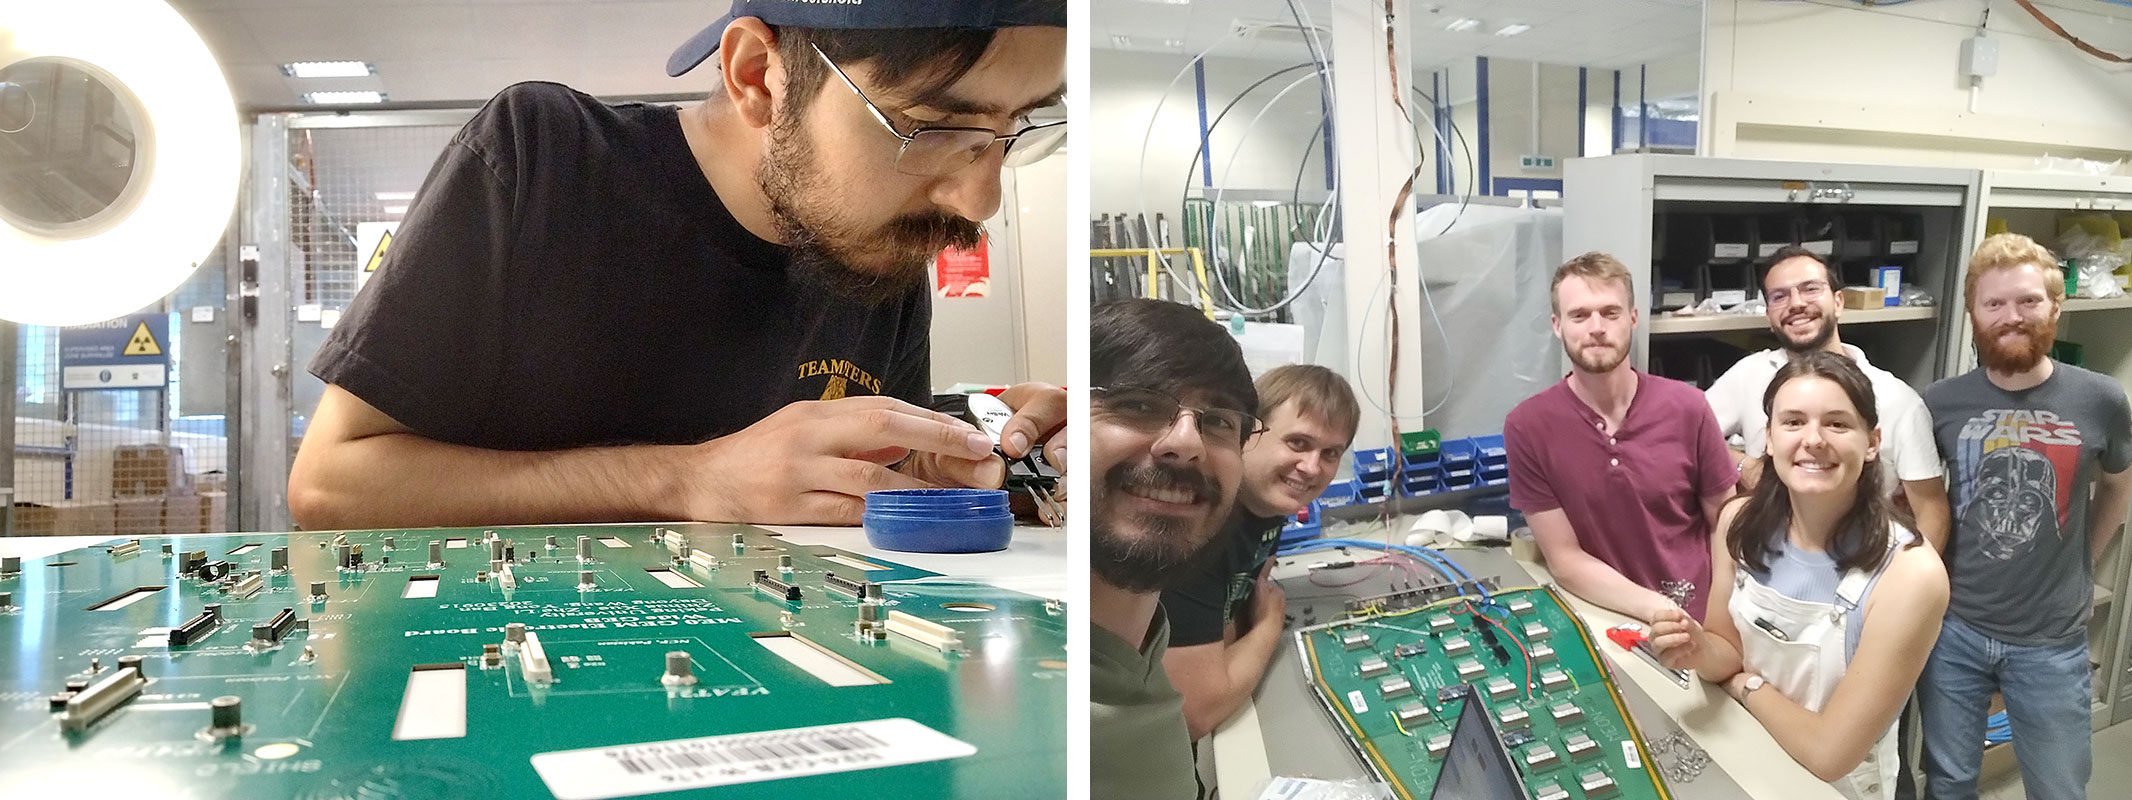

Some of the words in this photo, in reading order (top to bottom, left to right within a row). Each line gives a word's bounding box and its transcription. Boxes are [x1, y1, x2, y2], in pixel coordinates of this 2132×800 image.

[1968, 409, 2075, 427] STAR
[1958, 423, 2082, 446] WARS
[540, 609, 646, 618] University
[486, 622, 606, 633] Electroic
[614, 619, 678, 628] GEM
[405, 628, 478, 637] Board
